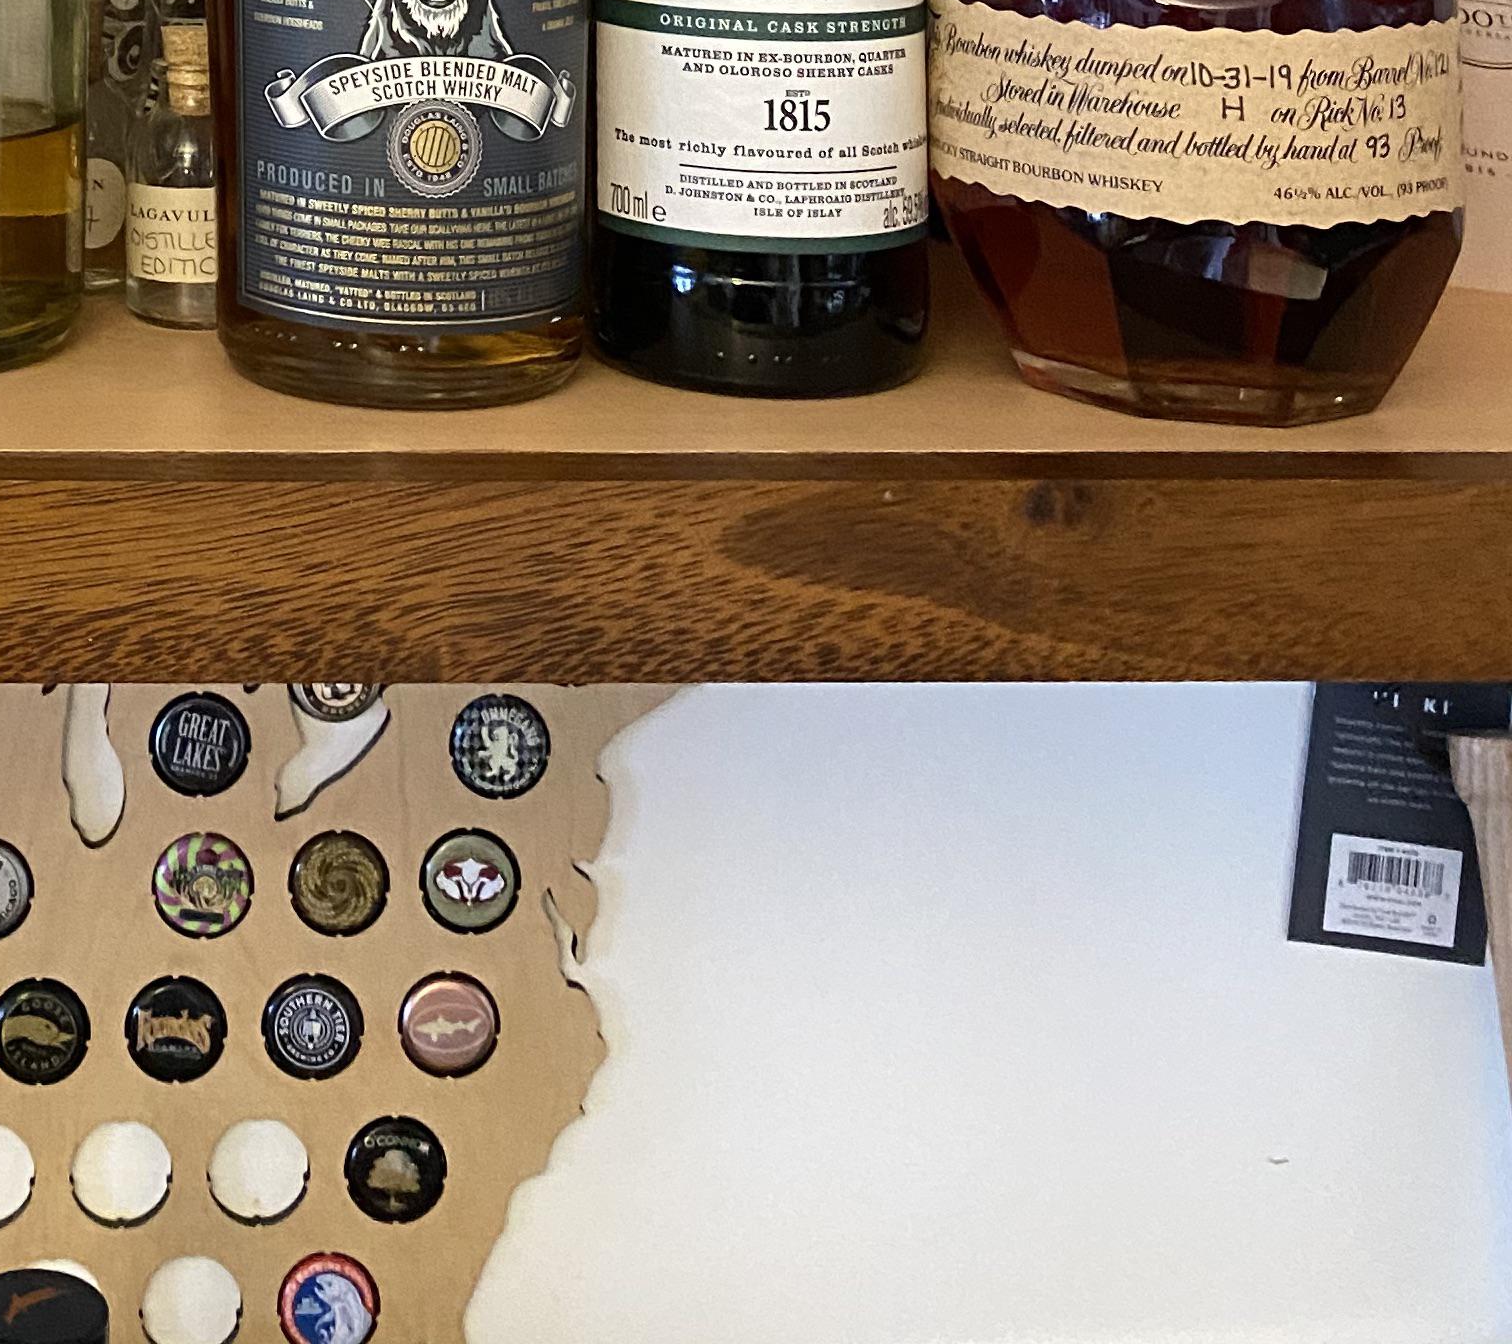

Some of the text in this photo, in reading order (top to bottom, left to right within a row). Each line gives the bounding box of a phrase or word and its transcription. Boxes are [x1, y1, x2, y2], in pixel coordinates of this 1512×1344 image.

[660, 13, 906, 34] ORIGINAL CASK STRENGTH
[661, 44, 754, 61] MATURED IN
[1005, 39, 1292, 90] whiskey dumped 10-31-19
[329, 61, 539, 96] SPEYSIDE BLENDED MALT
[683, 62, 893, 78] AND OLOROSO SHERRY CASKS
[372, 81, 503, 102] SCOTCH WHISKY
[764, 99, 831, 132] 1815
[1222, 95, 1245, 121] H
[615, 128, 900, 160] The most richly flavoured of all Scotch
[1136, 127, 1391, 160] and bottled 93
[257, 160, 386, 198] PRODUCED IN
[483, 171, 534, 198] SMALL
[679, 173, 847, 191] DISTILLED AND BOTTLED IN
[1013, 161, 1163, 193] BOURBON WHISKEY
[679, 186, 743, 202] JOHNSTON
[131, 204, 216, 222] LAGAVUL
[754, 207, 842, 218] ISLE OF ISLAY
[178, 711, 229, 746] GREAT
[174, 741, 223, 772] LAKES
[279, 994, 333, 1035] SOUTHERN
